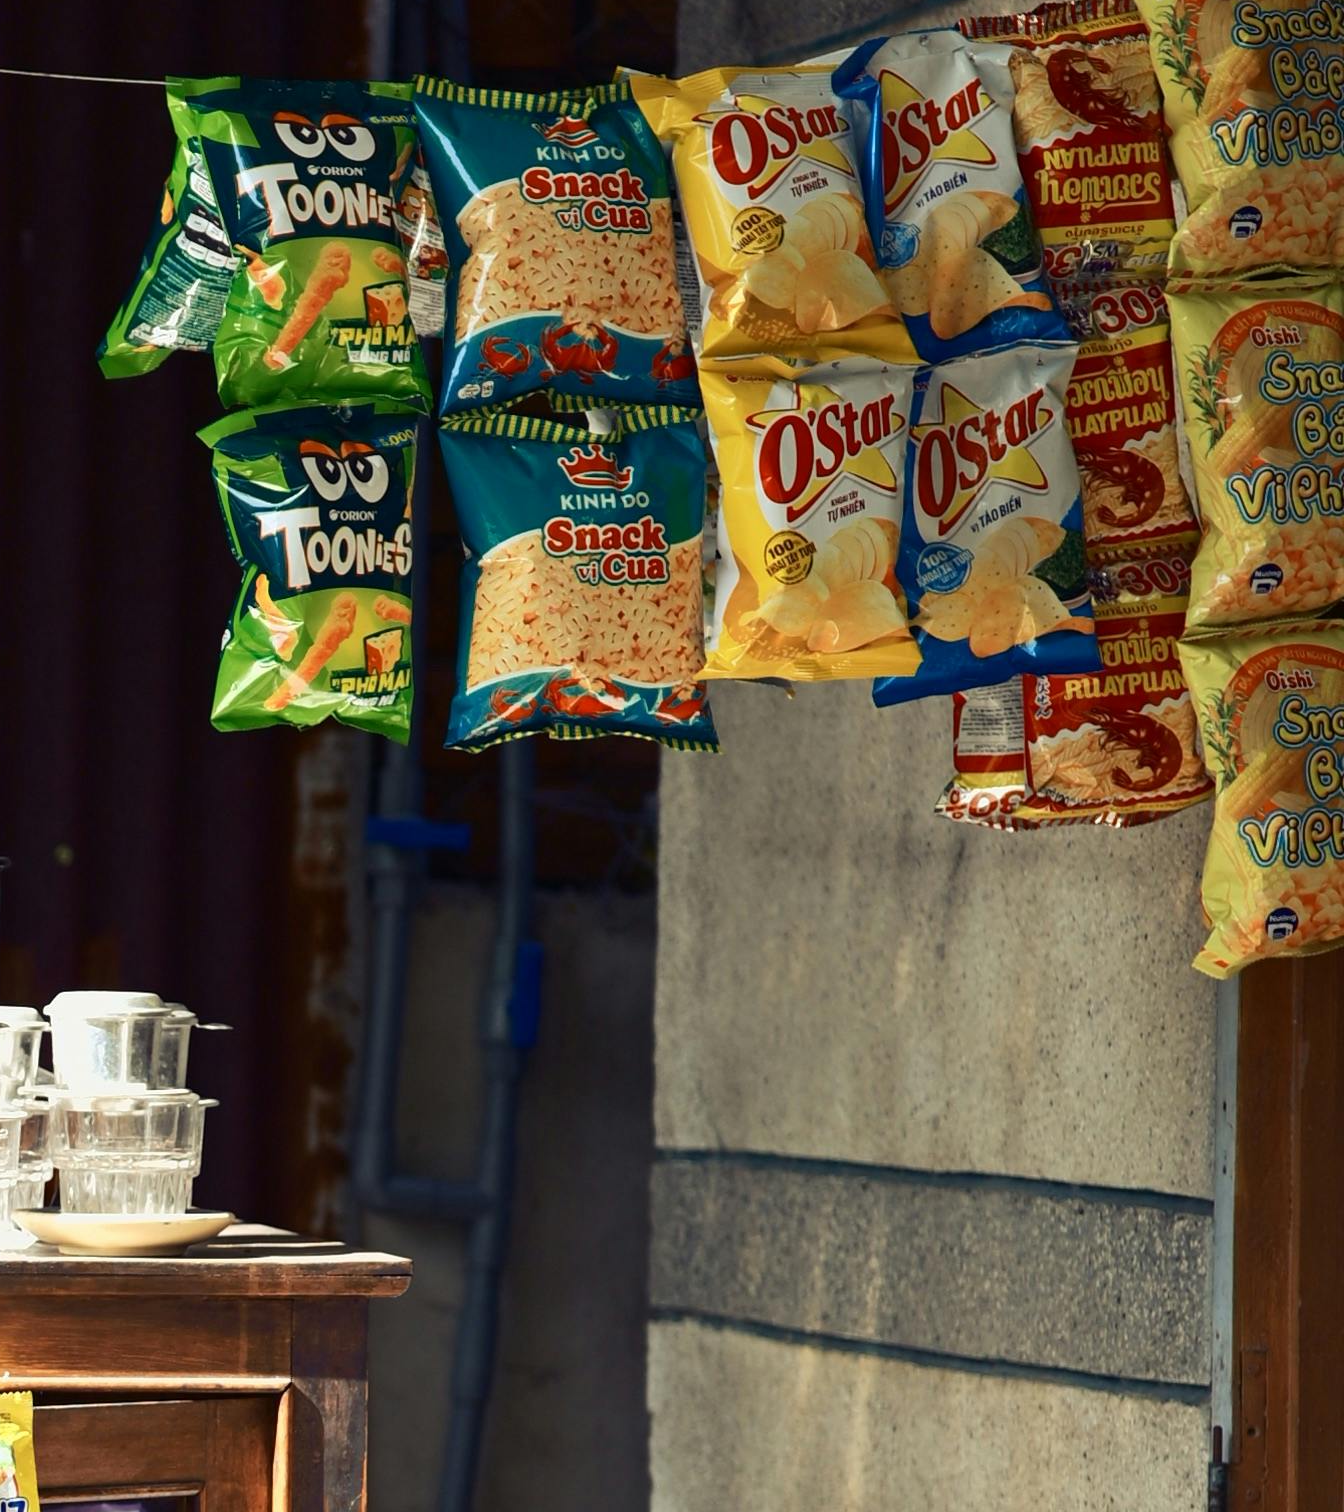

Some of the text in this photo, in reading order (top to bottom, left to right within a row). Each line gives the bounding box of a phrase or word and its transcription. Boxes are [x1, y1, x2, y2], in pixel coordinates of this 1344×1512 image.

[536, 145, 626, 164] KINH DO
[1043, 143, 1160, 170] RUAYPUAN
[320, 166, 365, 177] ORION
[522, 168, 648, 203] Snack
[583, 200, 650, 231] Cua
[385, 324, 417, 346] MA
[1249, 325, 1302, 349] Oishi
[1259, 350, 1344, 404] Sna
[1070, 401, 1168, 438] UAYPUAN
[758, 392, 895, 504] O'Star
[918, 388, 1044, 518] O'Star
[559, 490, 650, 511] KINH DO
[1287, 459, 1344, 524] Ph
[338, 509, 376, 522] ORION
[545, 516, 669, 555] Snack
[601, 551, 668, 582] Cua
[1063, 669, 1188, 701] RUAYPUAN
[1264, 669, 1315, 692] Oishi
